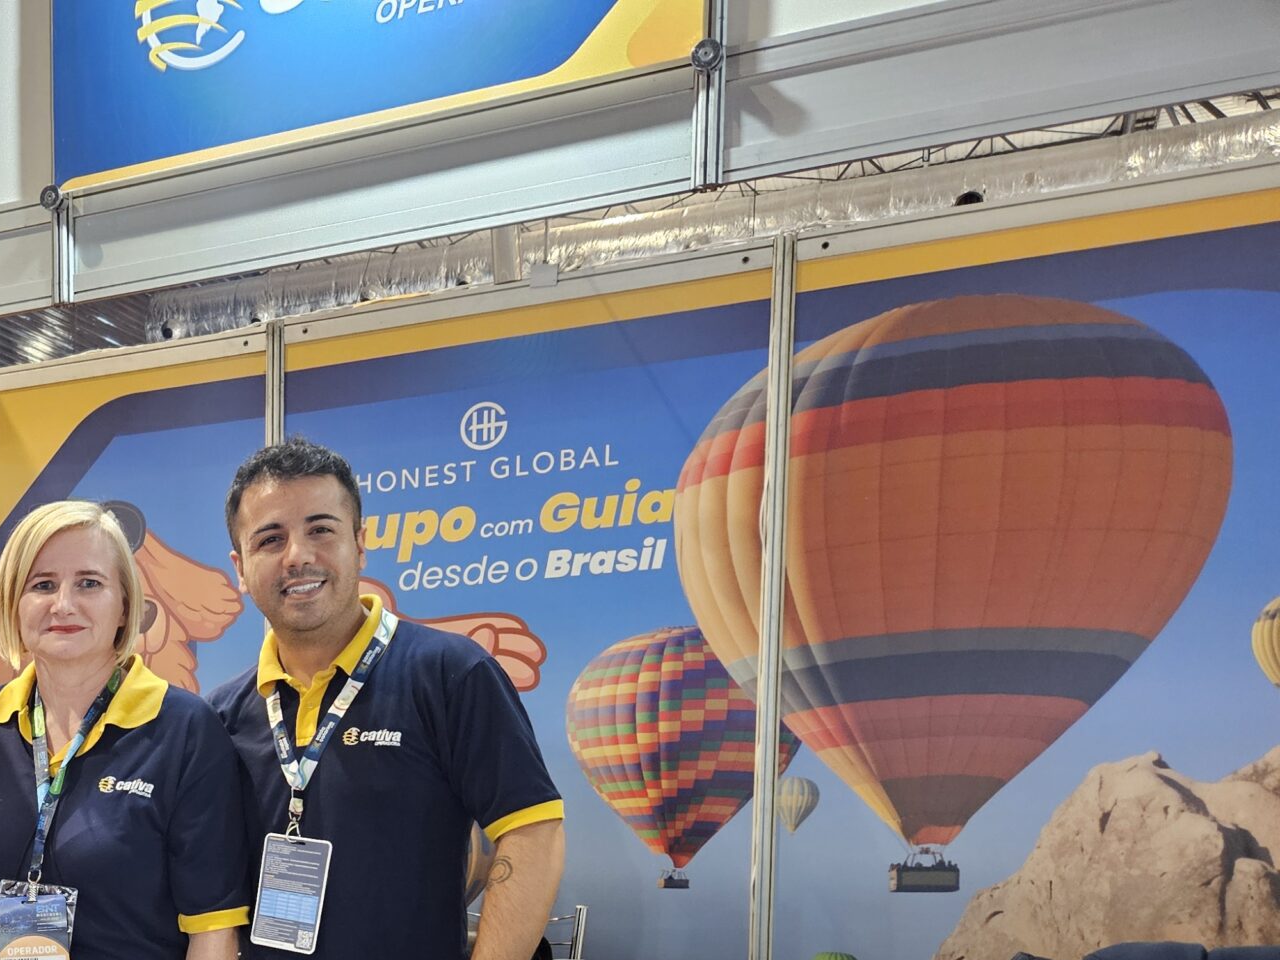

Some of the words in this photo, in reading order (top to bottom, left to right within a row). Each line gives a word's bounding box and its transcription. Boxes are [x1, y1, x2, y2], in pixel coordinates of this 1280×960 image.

[356, 460, 476, 494] HONEST
[490, 444, 619, 479] GLOBAL
[364, 505, 476, 563] upo
[480, 517, 533, 539] com
[539, 478, 676, 534] Guia
[398, 555, 509, 592] desde
[515, 558, 538, 582] o
[544, 536, 668, 579] Brasil
[360, 728, 402, 742] cativa
[115, 778, 155, 794] cativa
[7, 945, 58, 956] OPERADOR
